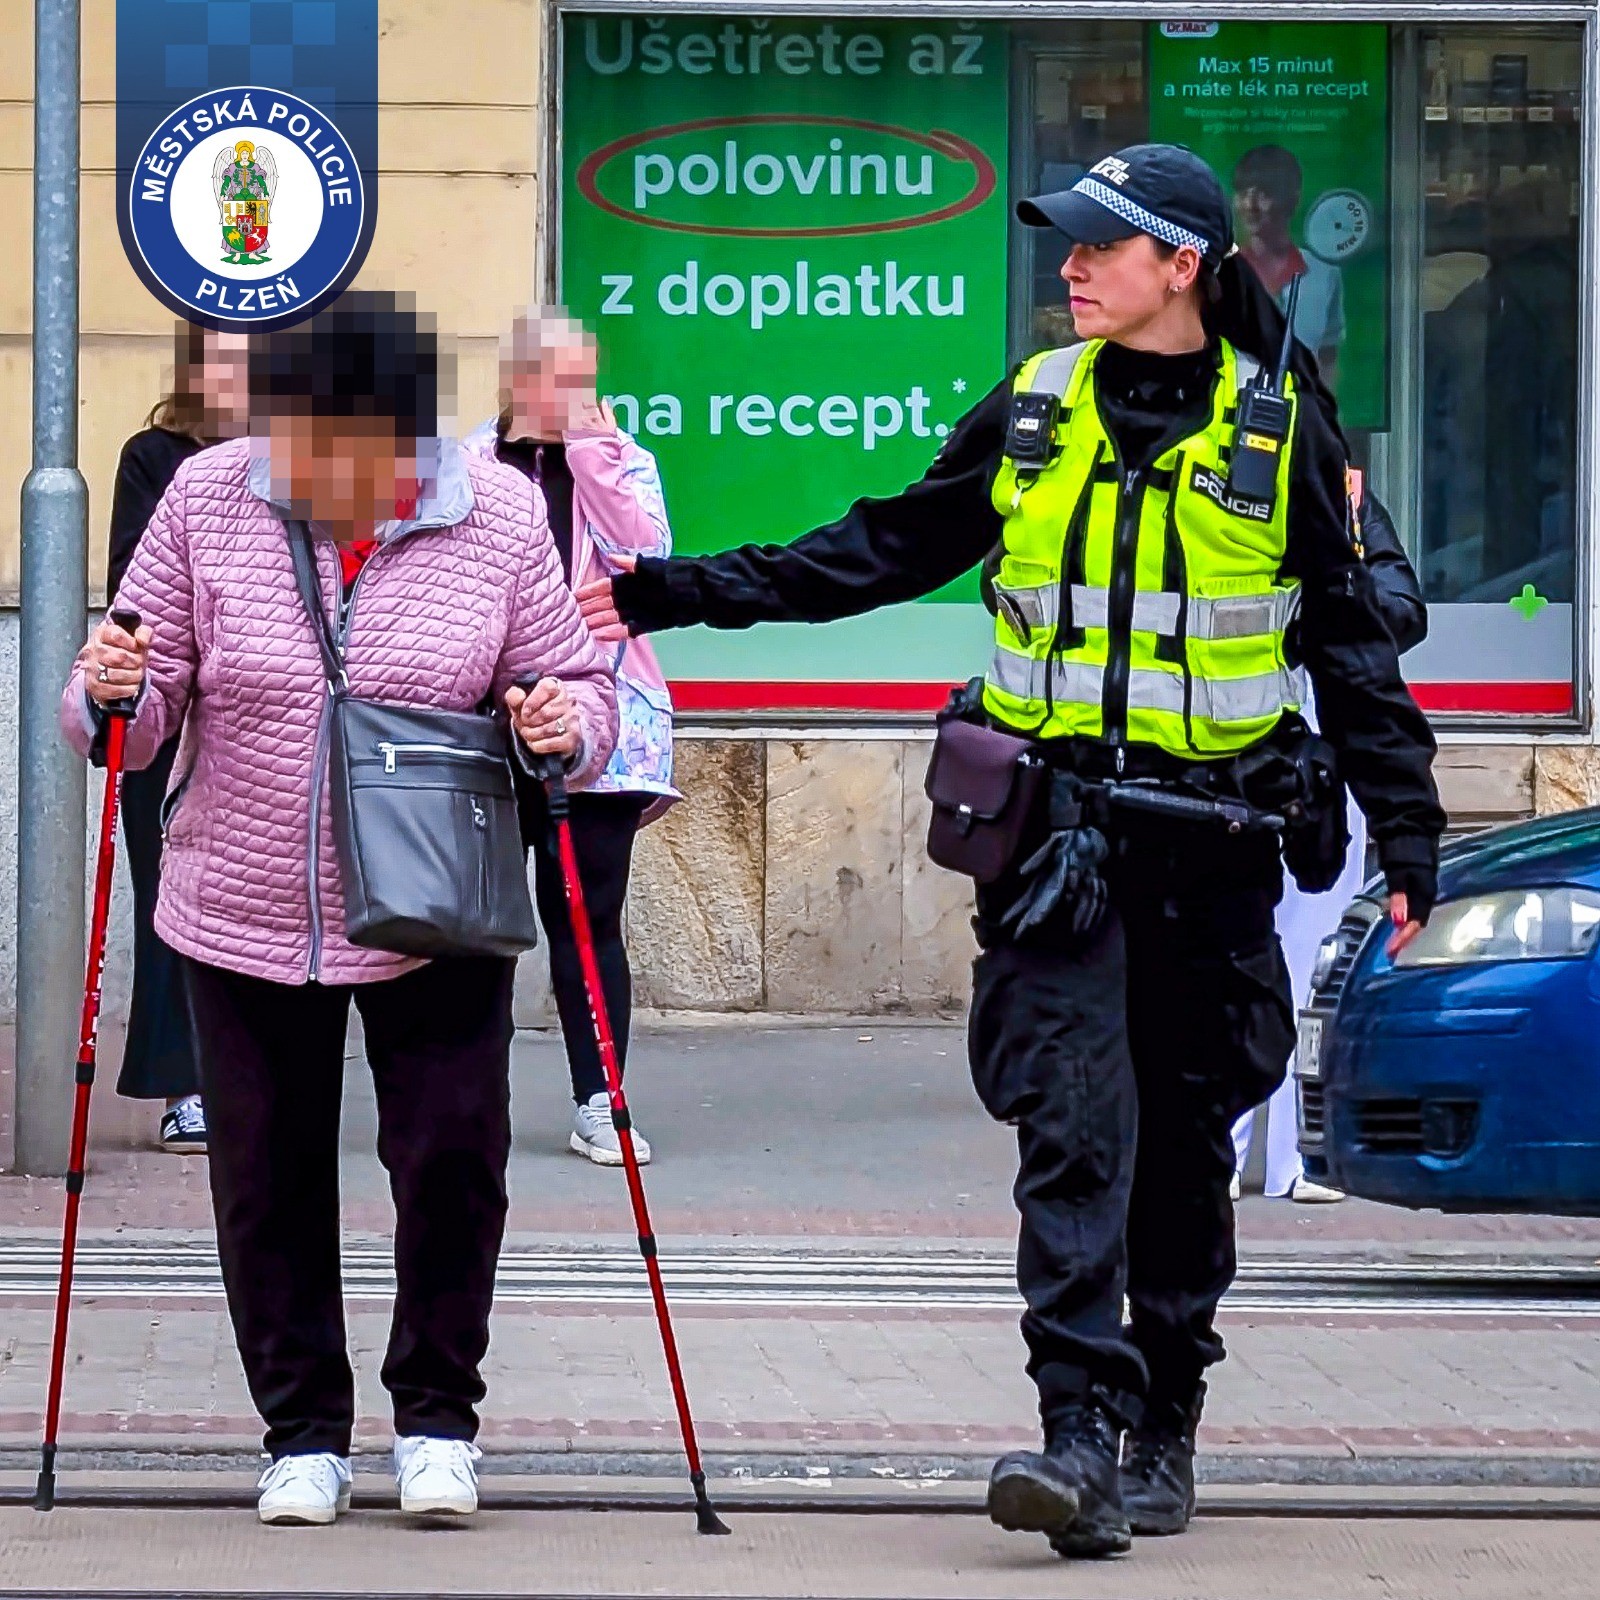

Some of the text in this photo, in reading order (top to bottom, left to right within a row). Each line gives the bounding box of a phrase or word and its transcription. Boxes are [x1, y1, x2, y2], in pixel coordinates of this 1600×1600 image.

[585, 18, 984, 75] Ušetřete až
[1199, 56, 1334, 73] Max 15 minut
[1163, 79, 1369, 99] a máte lék na recept
[634, 138, 933, 209] polovinu
[601, 261, 965, 330] z doplatku
[602, 394, 682, 436] na
[1194, 472, 1270, 520] POLICIE
